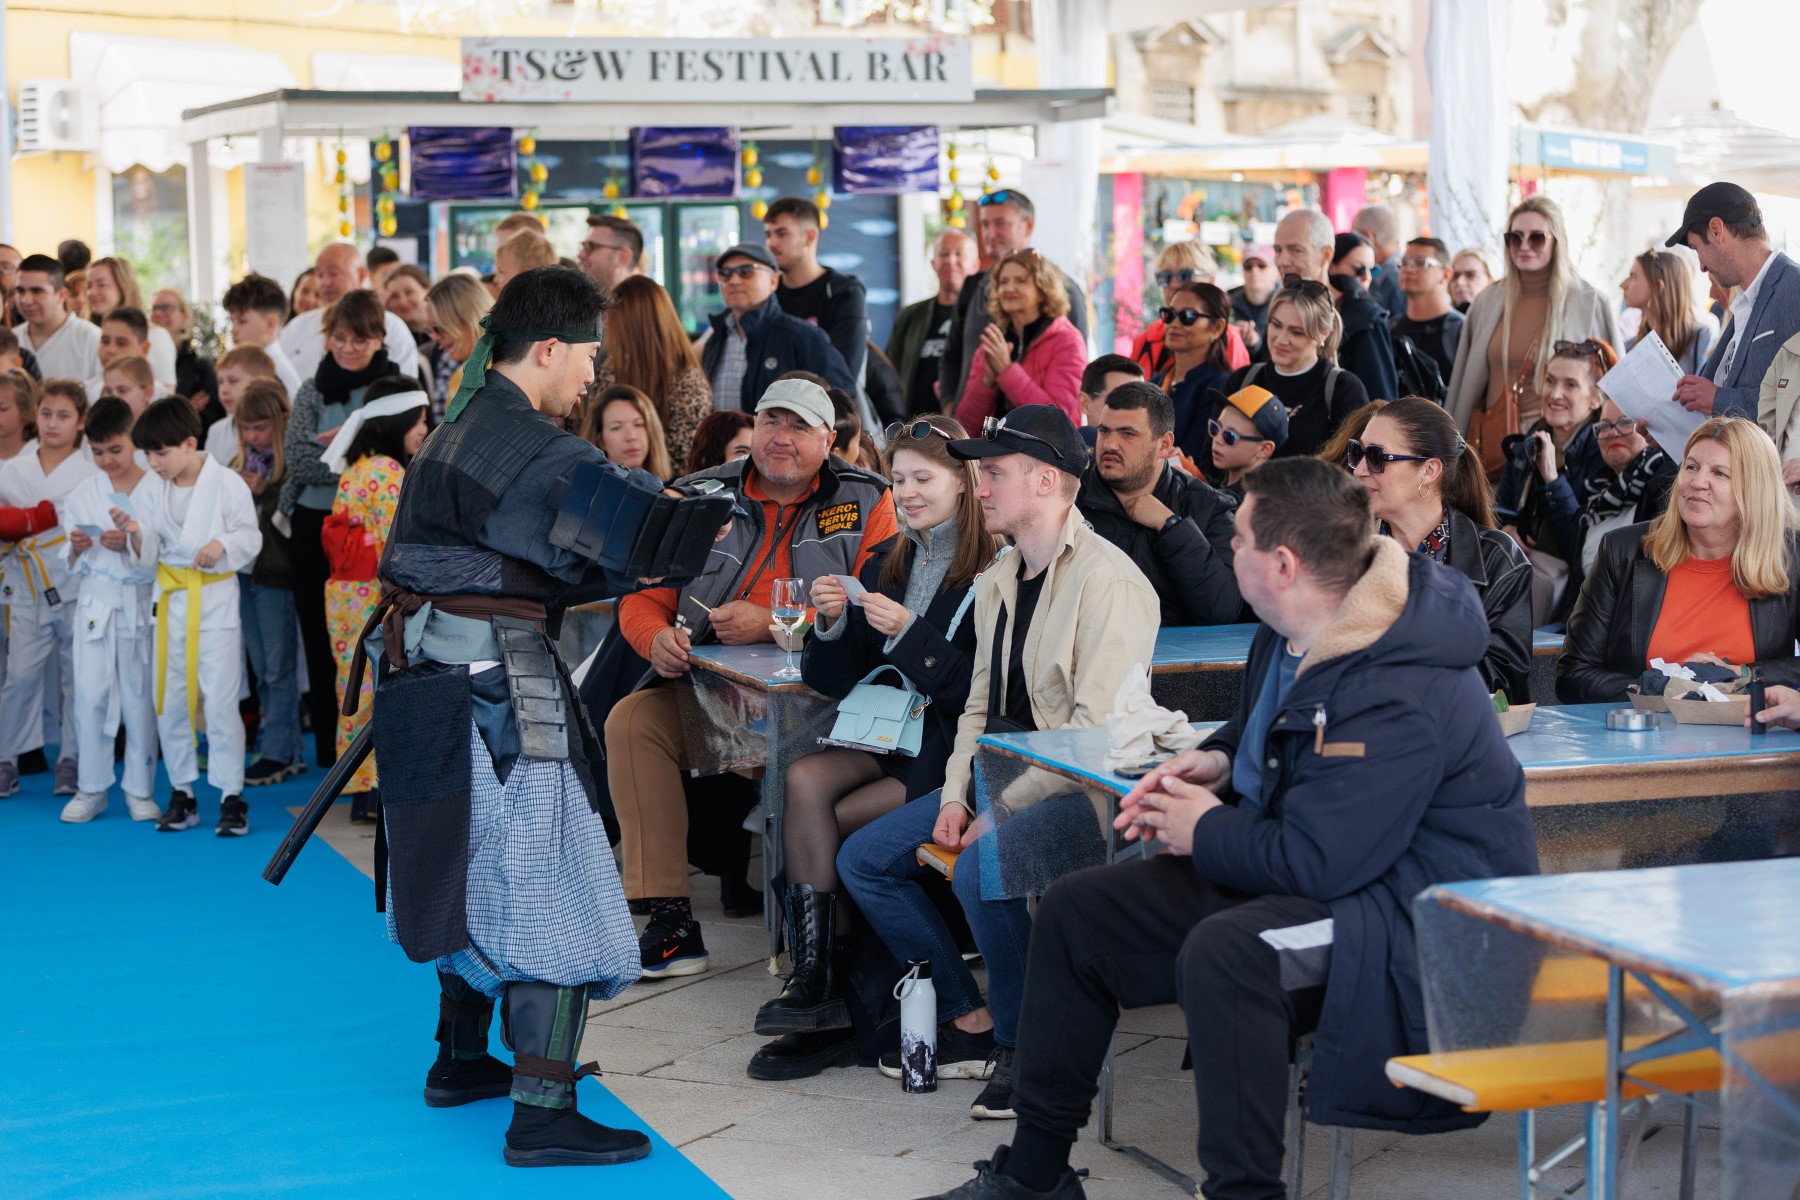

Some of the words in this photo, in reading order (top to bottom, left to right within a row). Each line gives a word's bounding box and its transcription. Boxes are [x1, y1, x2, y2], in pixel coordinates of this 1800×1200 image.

[492, 48, 632, 82] TS&W
[649, 49, 852, 82] FESTIVAL
[867, 51, 947, 82] BAR
[822, 503, 853, 518] KERO
[819, 512, 858, 528] SERVIS
